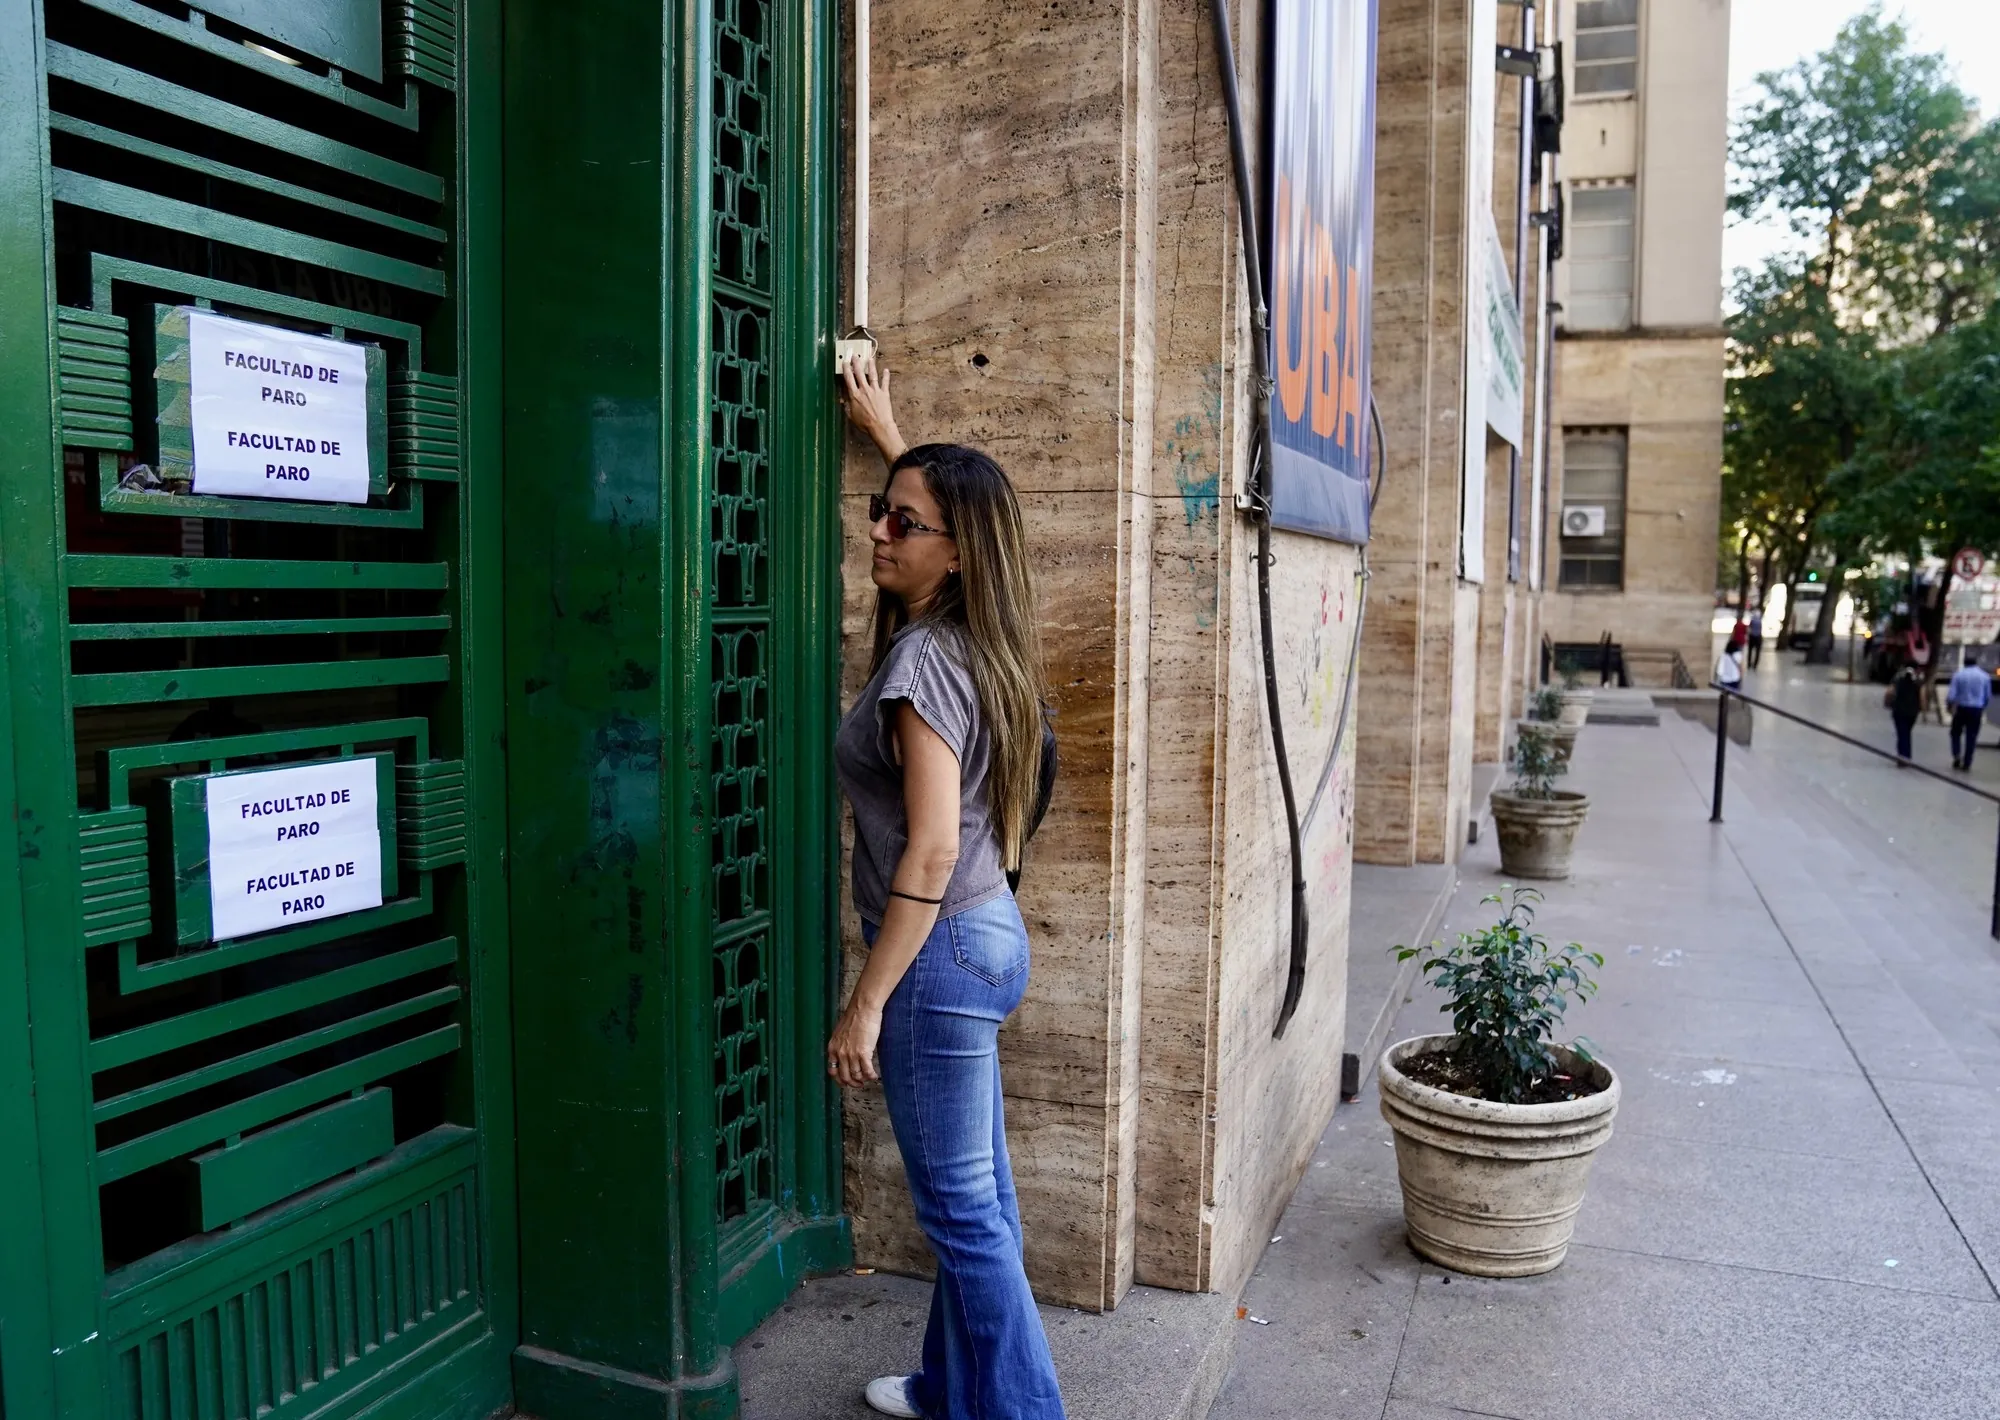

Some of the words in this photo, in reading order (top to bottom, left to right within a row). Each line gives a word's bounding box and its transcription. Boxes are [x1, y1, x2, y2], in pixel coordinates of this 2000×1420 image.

[1276, 171, 1360, 458] UBA
[225, 351, 313, 379] FACULTAD
[319, 367, 339, 384] DE
[262, 387, 306, 406] PARO
[228, 432, 316, 453] FACULTAD
[321, 441, 340, 455] DE
[266, 464, 309, 481] PARO
[242, 793, 326, 818] FACULTAD
[331, 789, 350, 804] DE
[278, 821, 319, 841] PARO
[247, 867, 330, 894] FACULTAD
[336, 862, 354, 877] DE
[282, 895, 324, 915] PARO
